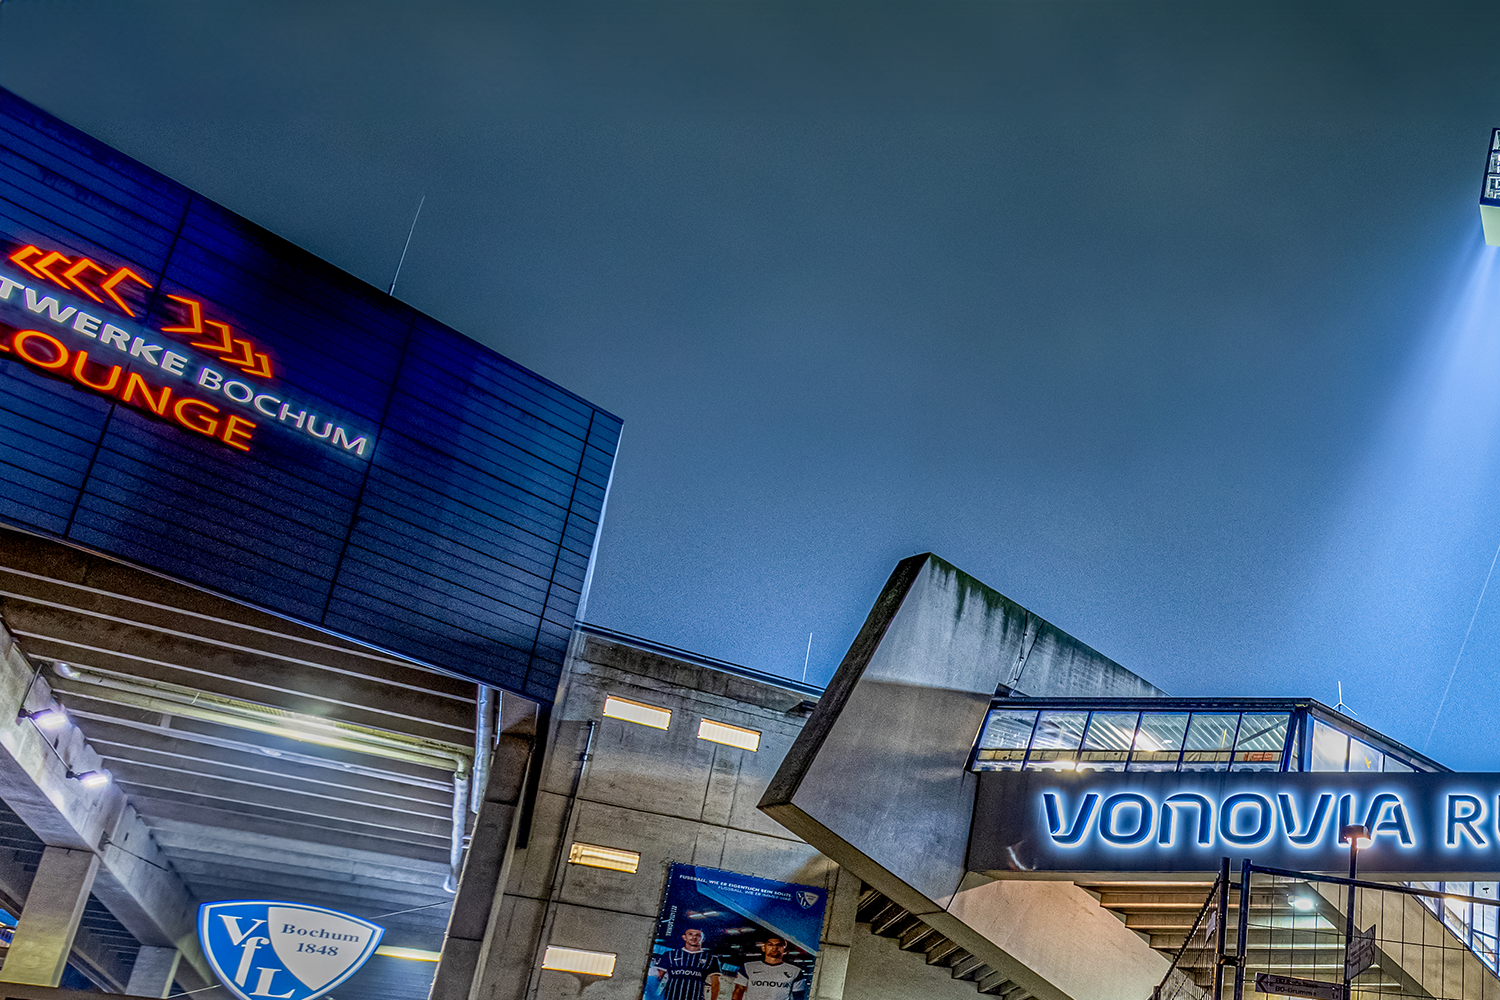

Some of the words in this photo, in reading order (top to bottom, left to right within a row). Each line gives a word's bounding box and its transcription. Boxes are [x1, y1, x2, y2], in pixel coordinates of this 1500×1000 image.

[0, 275, 188, 376] TWERKE
[198, 367, 367, 455] BOCHUM
[0, 329, 257, 451] OUNGE
[218, 914, 296, 999] VfL
[281, 923, 360, 943] Bochum
[296, 942, 339, 957] 1848
